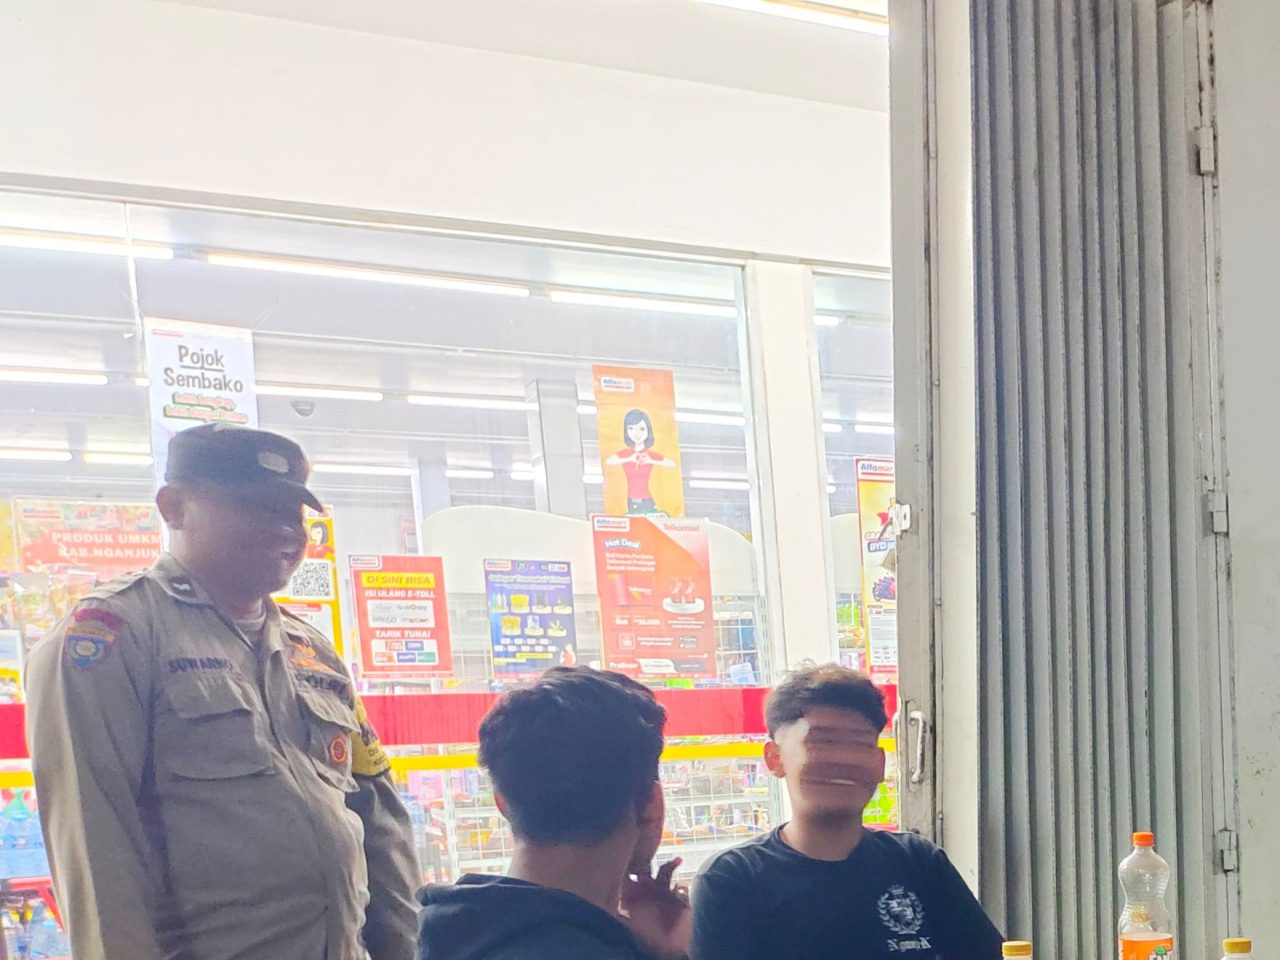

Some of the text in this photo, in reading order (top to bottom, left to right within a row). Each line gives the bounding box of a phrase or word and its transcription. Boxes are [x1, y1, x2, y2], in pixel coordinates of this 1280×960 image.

[178, 344, 225, 370] Pojok
[163, 367, 243, 393] Sembako
[664, 523, 700, 532] Telkomsel
[52, 532, 161, 544] PRODUK UMKM
[366, 575, 431, 585] DI SINI BISA
[407, 590, 435, 598] E-TOLL
[376, 630, 431, 638] TARIK TUNAI
